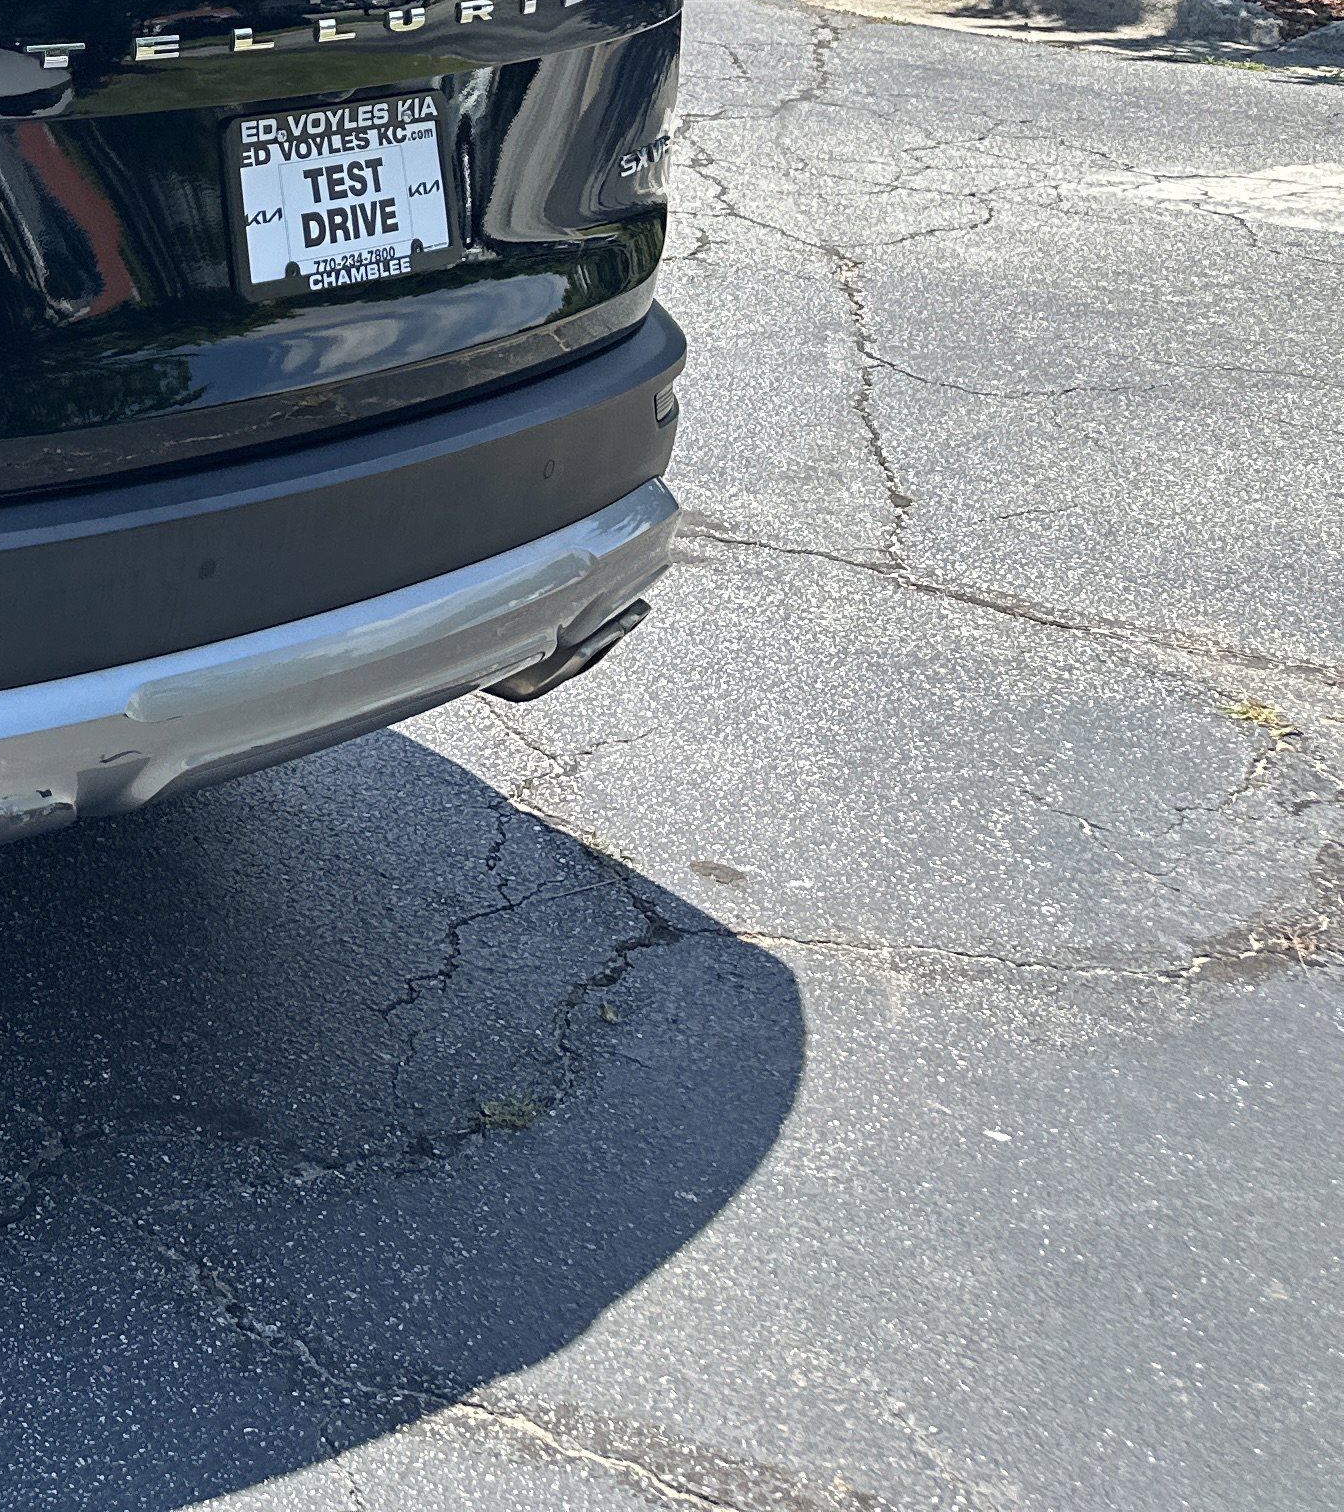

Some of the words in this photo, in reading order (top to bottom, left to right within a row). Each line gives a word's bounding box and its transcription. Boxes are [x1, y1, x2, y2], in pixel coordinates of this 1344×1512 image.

[240, 118, 277, 144] ED
[287, 102, 389, 137] VOYLES
[397, 95, 438, 122] KIA
[278, 128, 370, 162] VOYLES
[302, 157, 384, 203] TEST
[300, 197, 400, 249] DRIVE
[309, 257, 412, 290] CHAMBLEE
[313, 246, 396, 273] 770-234-7800
